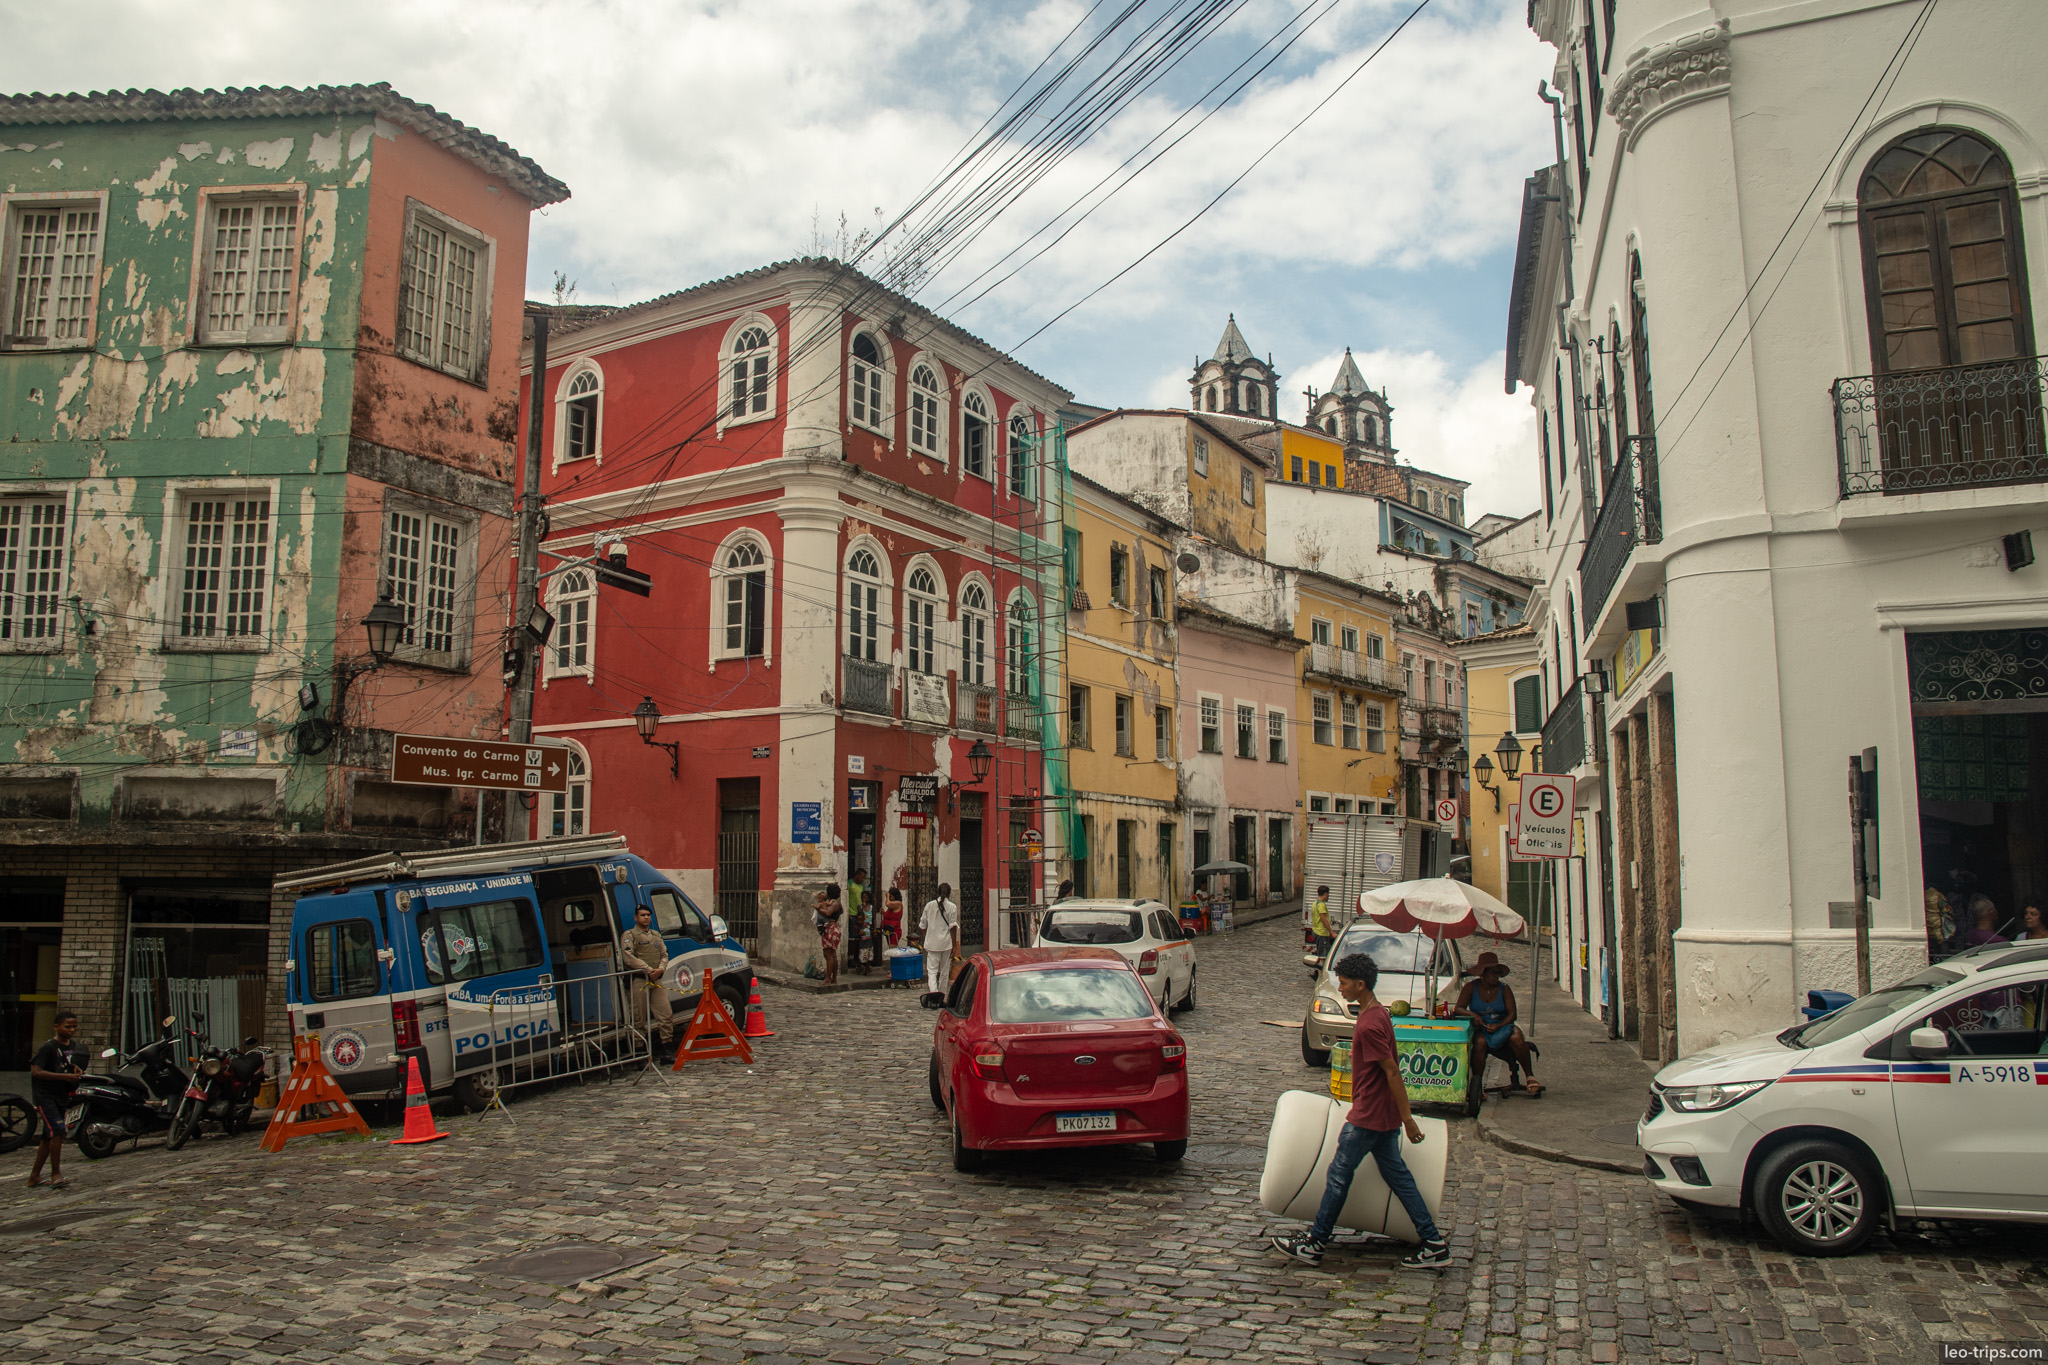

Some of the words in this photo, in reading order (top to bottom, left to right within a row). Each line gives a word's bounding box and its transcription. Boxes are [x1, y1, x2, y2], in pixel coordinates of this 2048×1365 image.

[402, 744, 458, 758] Convento
[463, 749, 477, 759] do
[483, 750, 520, 762] Carmo
[422, 766, 450, 777] Mus.
[456, 768, 475, 781] Igr.
[481, 770, 519, 782] Carmo
[901, 777, 935, 789] Mercado
[1540, 791, 1554, 811] E
[901, 816, 924, 826] BRAHMA
[1524, 824, 1566, 834] Veículos
[1526, 838, 1563, 849] Oficis
[425, 881, 479, 897] SEGURANÇA
[485, 875, 522, 889] UNIDADE
[425, 1020, 449, 1033] BTS
[1398, 1047, 1459, 1077] CÔCO
[1410, 1076, 1452, 1086] SALVADOR
[1958, 1066, 2031, 1083] A-5918
